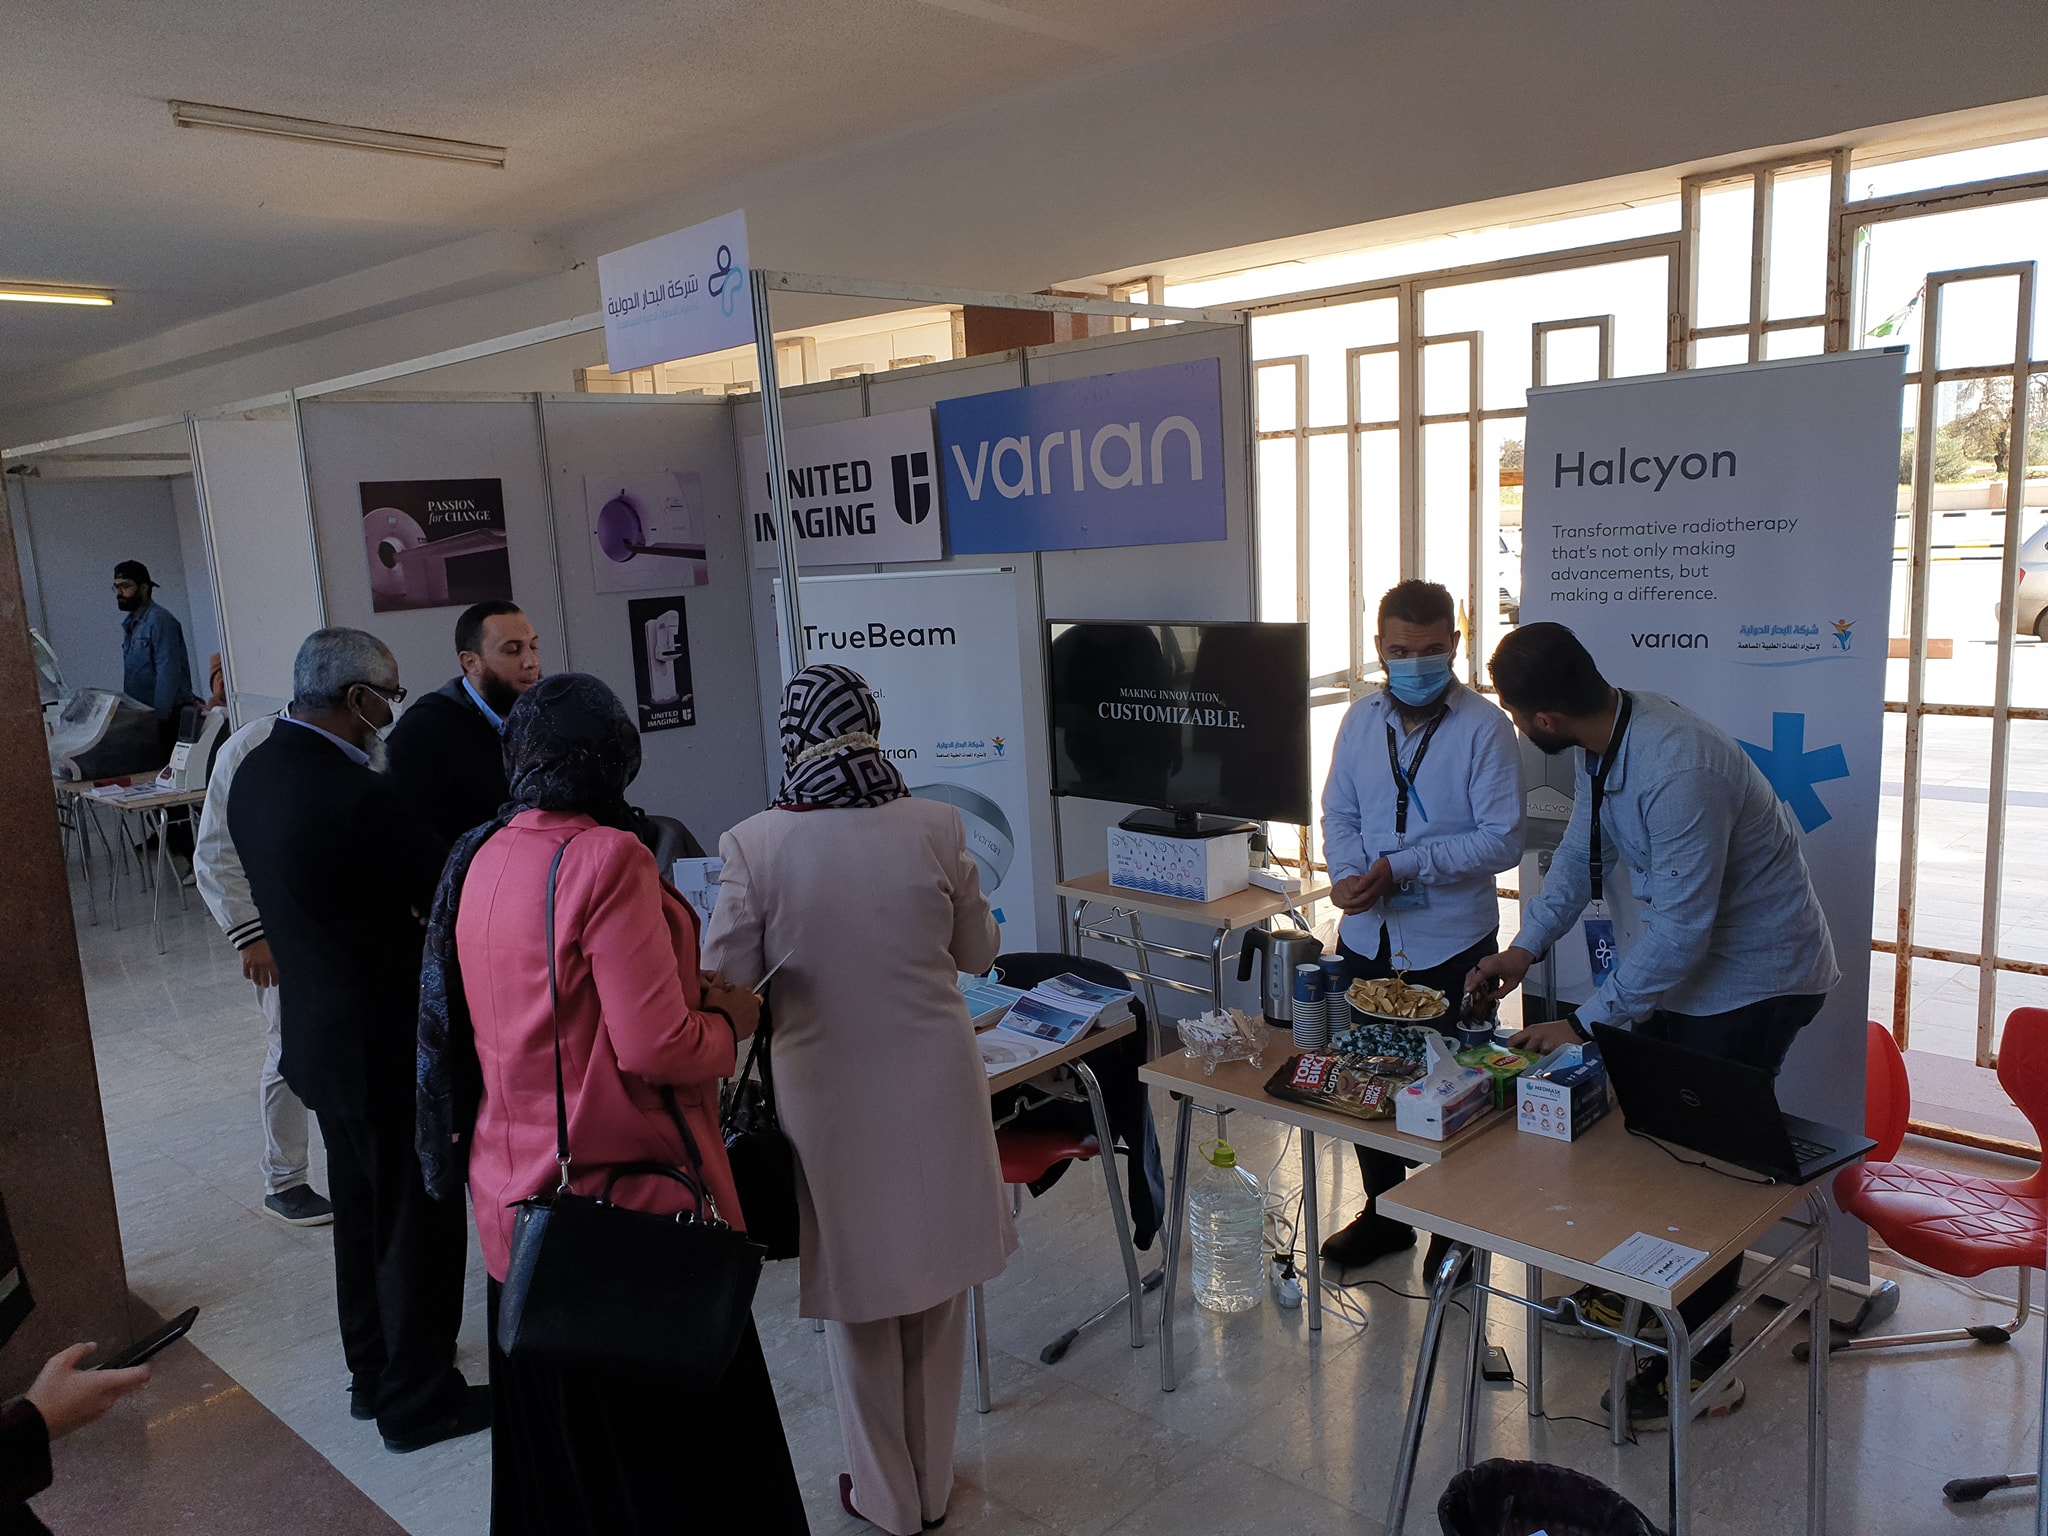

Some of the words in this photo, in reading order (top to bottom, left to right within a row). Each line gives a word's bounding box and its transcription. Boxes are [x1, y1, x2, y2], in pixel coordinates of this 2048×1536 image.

[643, 284, 666, 311] البحار
[667, 274, 699, 302] شركة
[608, 292, 640, 318] الدولية
[951, 415, 1203, 501] varian
[1554, 447, 1737, 492] Halcyon
[428, 499, 475, 511] PASSION
[429, 512, 443, 525] for
[444, 510, 491, 522] CHANGE
[1552, 521, 1677, 538] Transformative
[1682, 517, 1799, 533] radiotherapy
[1552, 544, 1597, 560] that's
[1602, 545, 1629, 559] not
[1633, 542, 1668, 560] only
[1672, 541, 1736, 558] making
[1551, 566, 1674, 581] advancements,
[1680, 563, 1709, 579] but
[1550, 587, 1608, 604] making
[1613, 589, 1623, 601] a
[1628, 586, 1717, 601] difference.
[803, 622, 956, 651] TrueBeam
[1740, 624, 1769, 637] الدولية
[1770, 624, 1792, 636] البحار
[1793, 624, 1819, 636] شركة
[1630, 632, 1709, 649] varian
[1119, 687, 1157, 699] MAKING
[647, 717, 680, 728] IMAGING
[651, 710, 679, 720] UNITED
[1098, 701, 1246, 729] CUSTOMIZABLE.
[879, 748, 918, 760] arian
[973, 829, 1001, 857] varian
[1293, 1053, 1316, 1084] TORA
[1306, 1055, 1327, 1084] BIKA
[1362, 1084, 1375, 1104] TORA
[1370, 1086, 1382, 1105] BIKA
